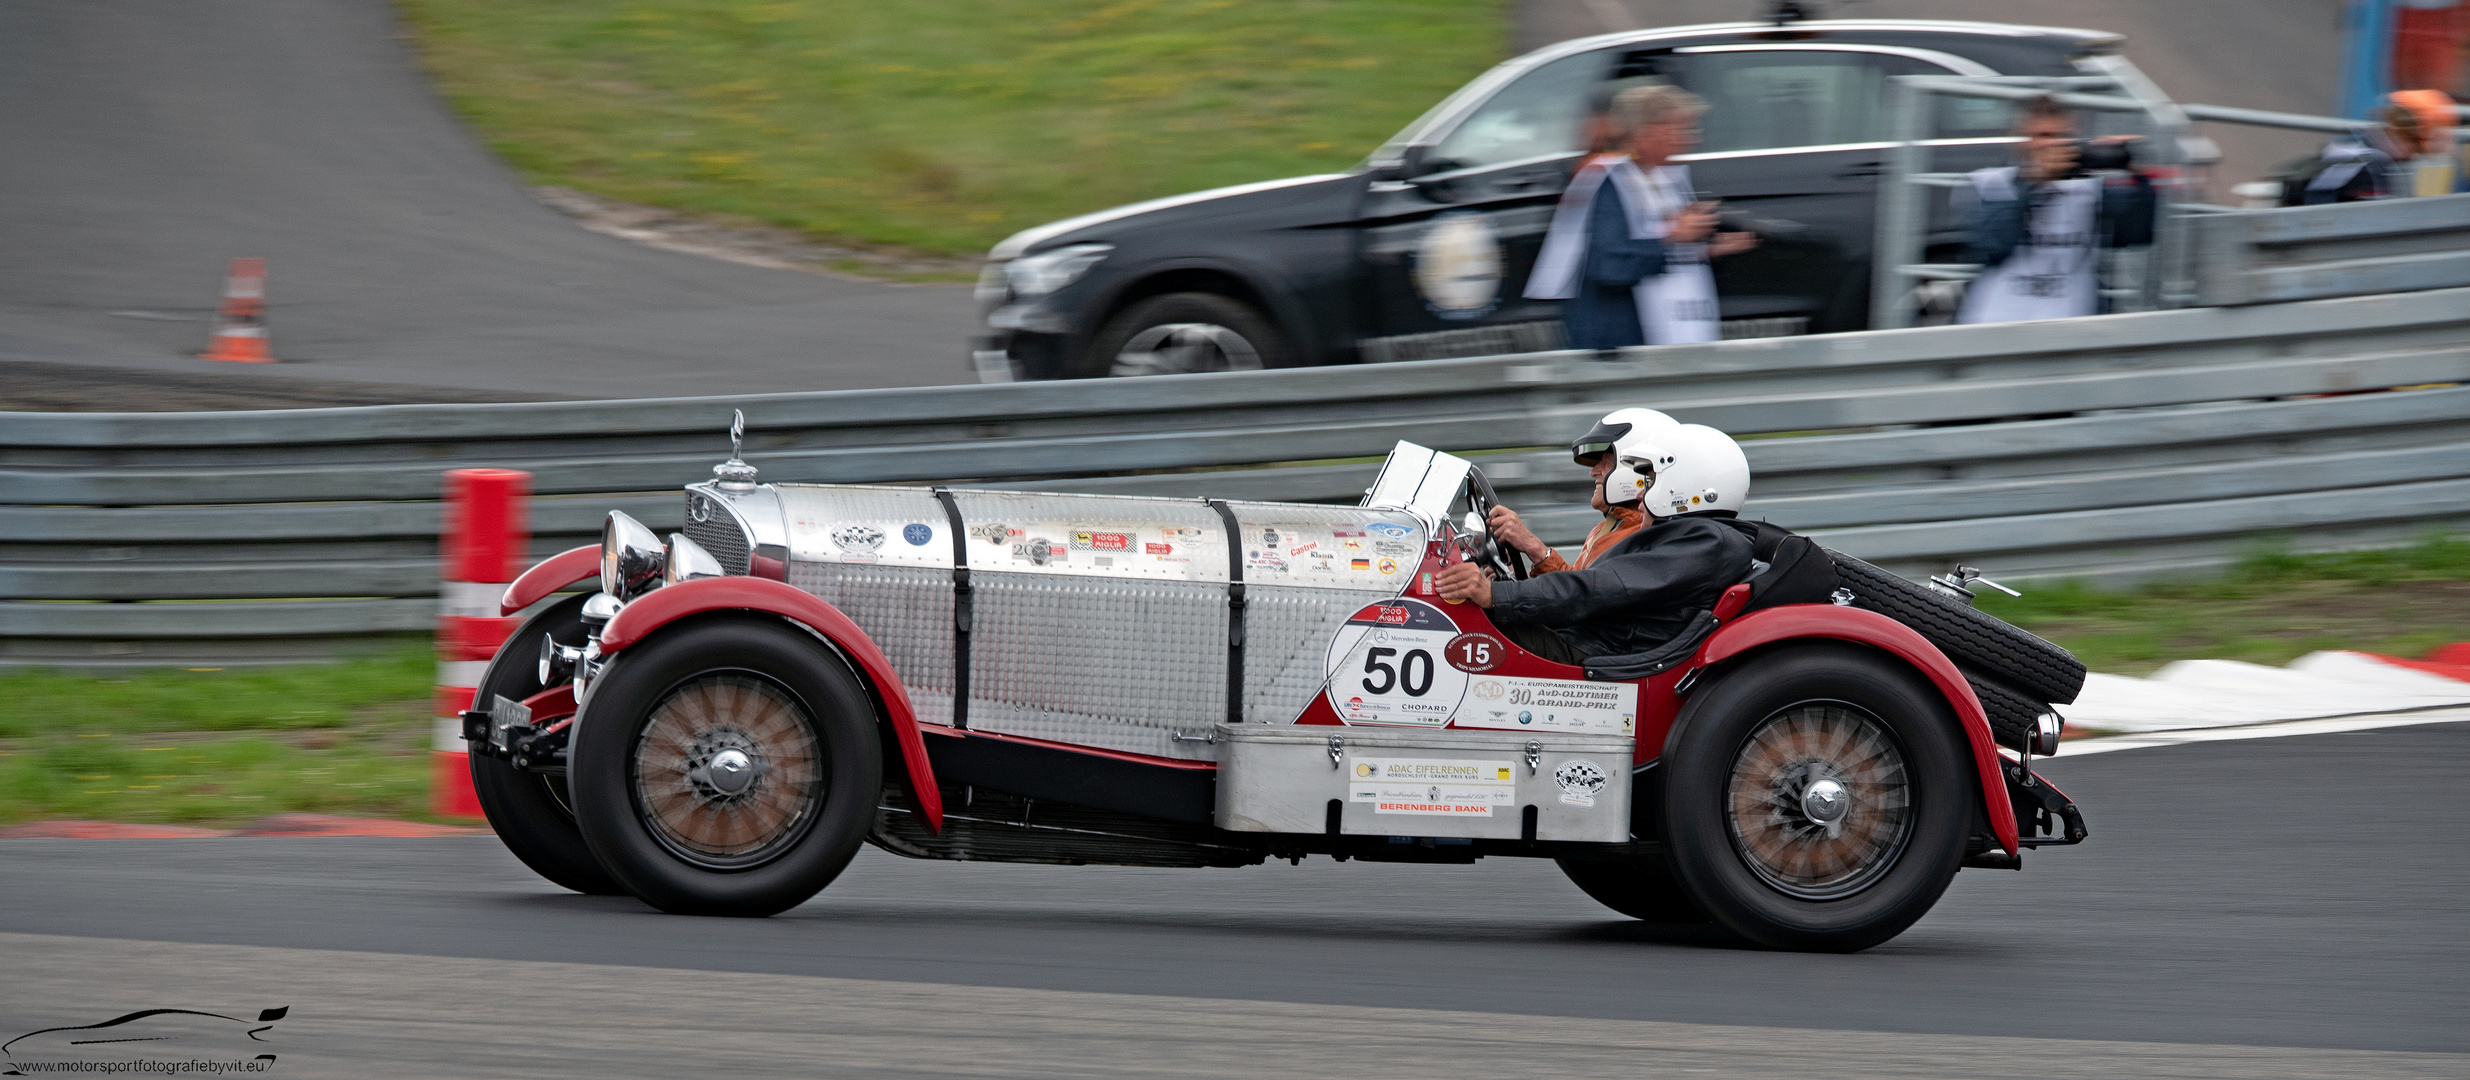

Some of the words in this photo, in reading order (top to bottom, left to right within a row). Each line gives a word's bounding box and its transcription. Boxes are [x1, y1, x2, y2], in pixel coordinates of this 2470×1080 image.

[1290, 541, 1317, 556] Castrol
[1462, 643, 1490, 664] 15
[1362, 647, 1434, 697] 50
[1469, 664, 1494, 672] MEMORIAL
[1528, 682, 1618, 691] EUROPAMEISTERSCHAFT
[1509, 688, 1536, 705] 30.
[1538, 690, 1618, 700] AvD-OLDTIMER
[1402, 704, 1448, 712] CHOPARD
[1536, 699, 1618, 710] GRAND-PRIX
[1388, 765, 1412, 774] ADAC
[1416, 766, 1478, 774] EIFELRENNEN
[1380, 803, 1451, 812] BERENBERG
